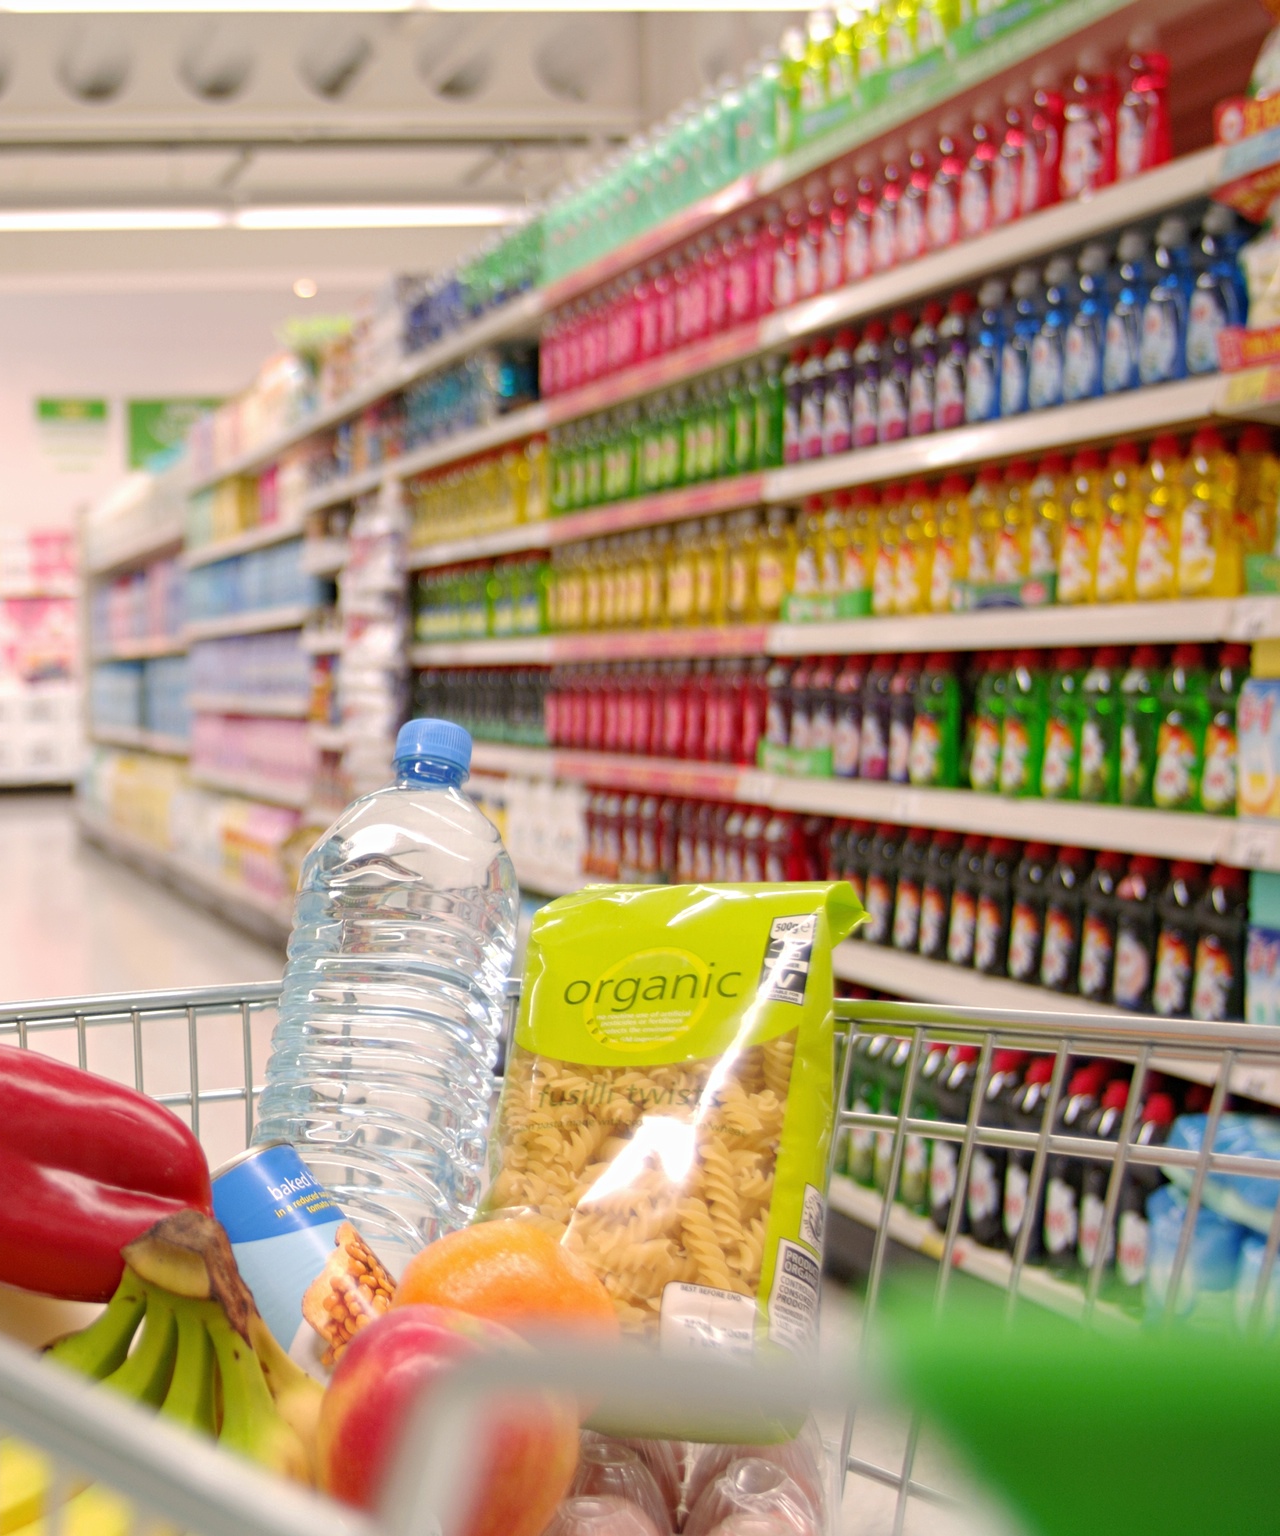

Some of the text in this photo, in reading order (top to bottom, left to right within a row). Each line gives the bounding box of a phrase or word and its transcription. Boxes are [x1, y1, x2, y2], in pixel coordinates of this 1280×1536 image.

[563, 962, 742, 1012] organic
[538, 1082, 723, 1108] fusilli twists
[266, 1171, 311, 1201] baked
[274, 1208, 287, 1219] in
[285, 1204, 294, 1213] a
[292, 1190, 320, 1209] reduced
[699, 1287, 726, 1300] BEFORE
